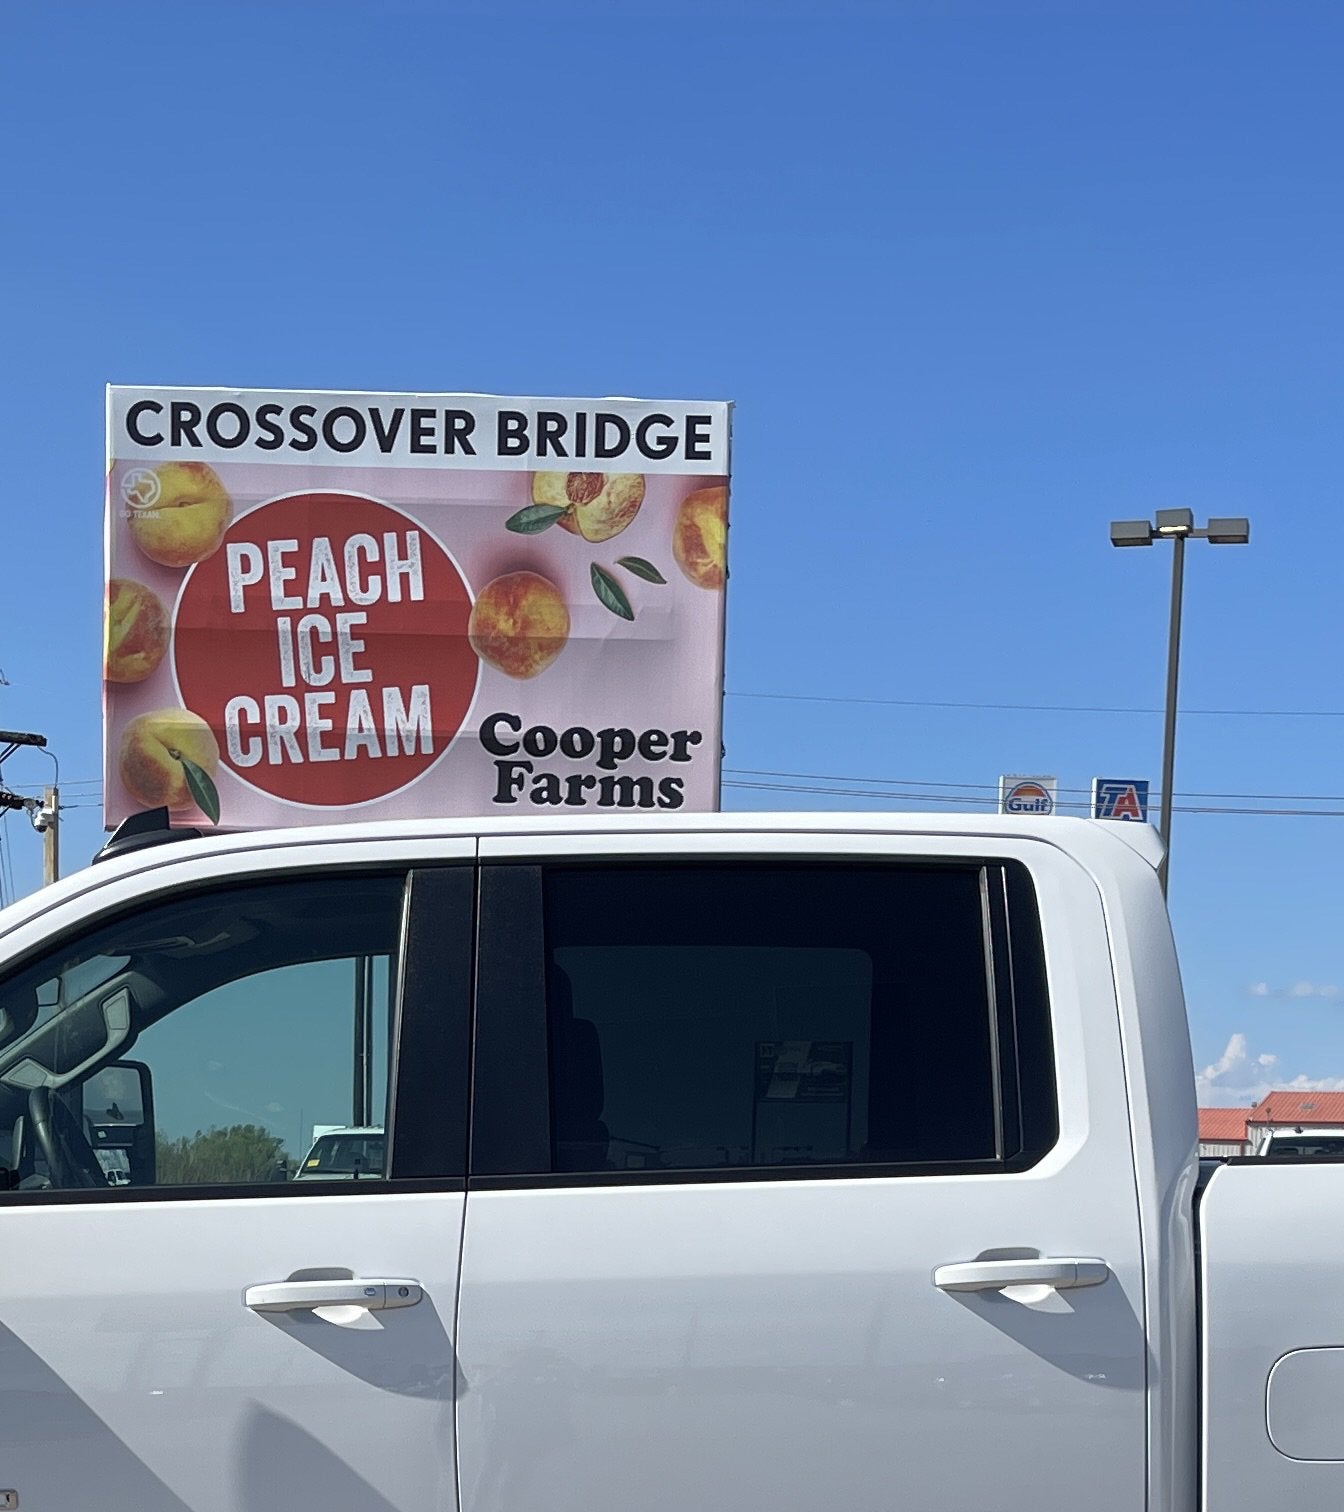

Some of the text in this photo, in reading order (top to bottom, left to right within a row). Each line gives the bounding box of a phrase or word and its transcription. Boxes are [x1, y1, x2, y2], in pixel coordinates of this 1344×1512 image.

[126, 400, 713, 461] CROSSOVER BRIDGE
[226, 530, 425, 613] PEACH
[277, 611, 374, 688] ICE
[224, 684, 435, 768] CREAM
[479, 712, 703, 770] Cooper
[492, 759, 685, 810] Farms
[1008, 797, 1049, 812] Gulf
[1099, 783, 1145, 820] TA
